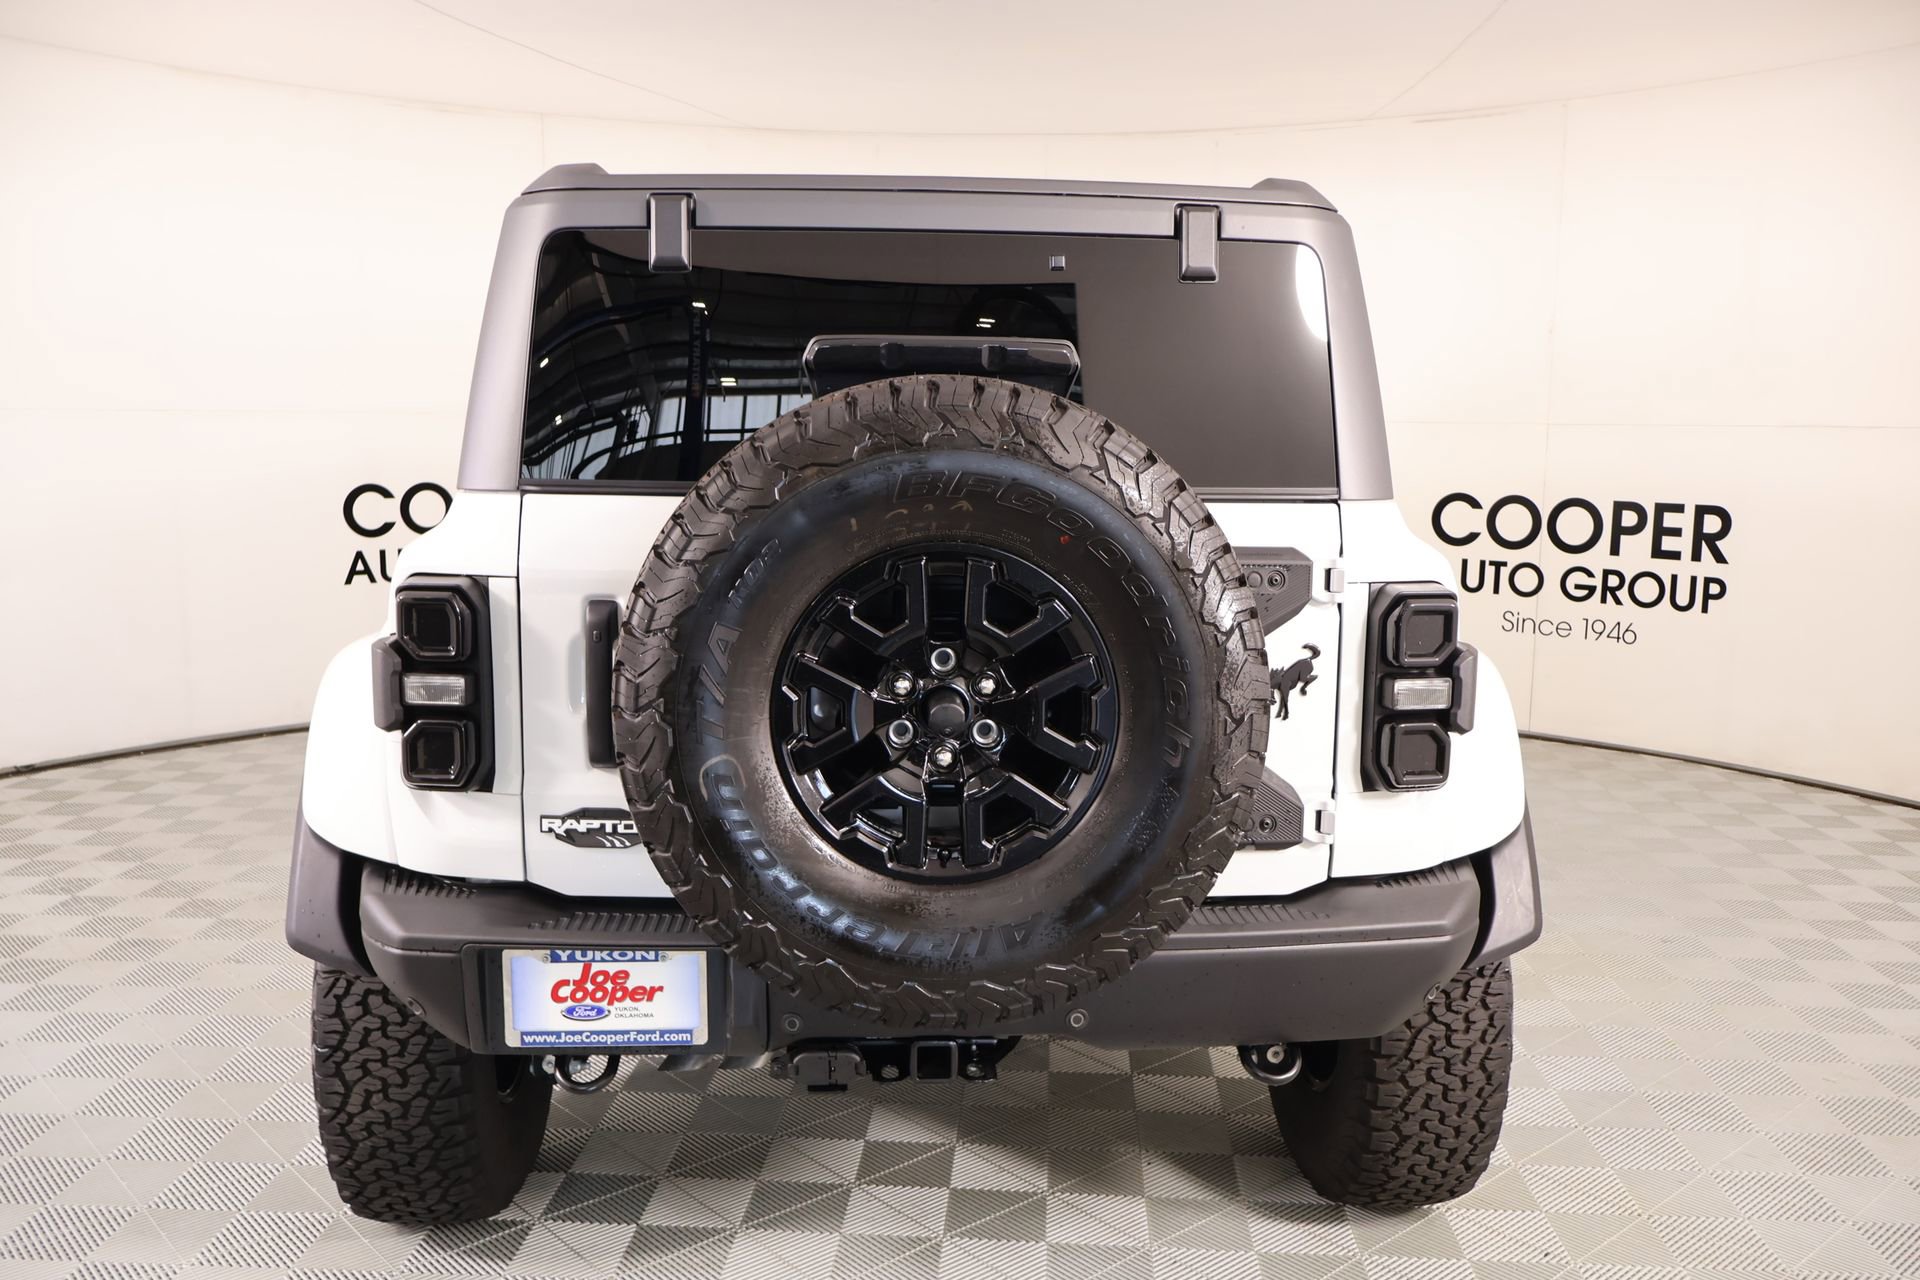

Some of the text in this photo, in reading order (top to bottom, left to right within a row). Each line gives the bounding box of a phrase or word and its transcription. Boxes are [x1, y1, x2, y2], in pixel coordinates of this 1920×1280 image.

[343, 482, 454, 538] CO
[1431, 492, 1733, 565] COOPER
[344, 548, 402, 586] AU
[1460, 558, 1728, 614] UTO GROUP
[1501, 611, 1638, 645] Since 1946
[541, 818, 639, 836] RAPTO
[551, 950, 656, 961] YUKON
[573, 962, 630, 986] Joe
[551, 979, 664, 1006] Cooper
[572, 1006, 598, 1017] Ford
[523, 1032, 691, 1044] www.JoeCooperFord.com
